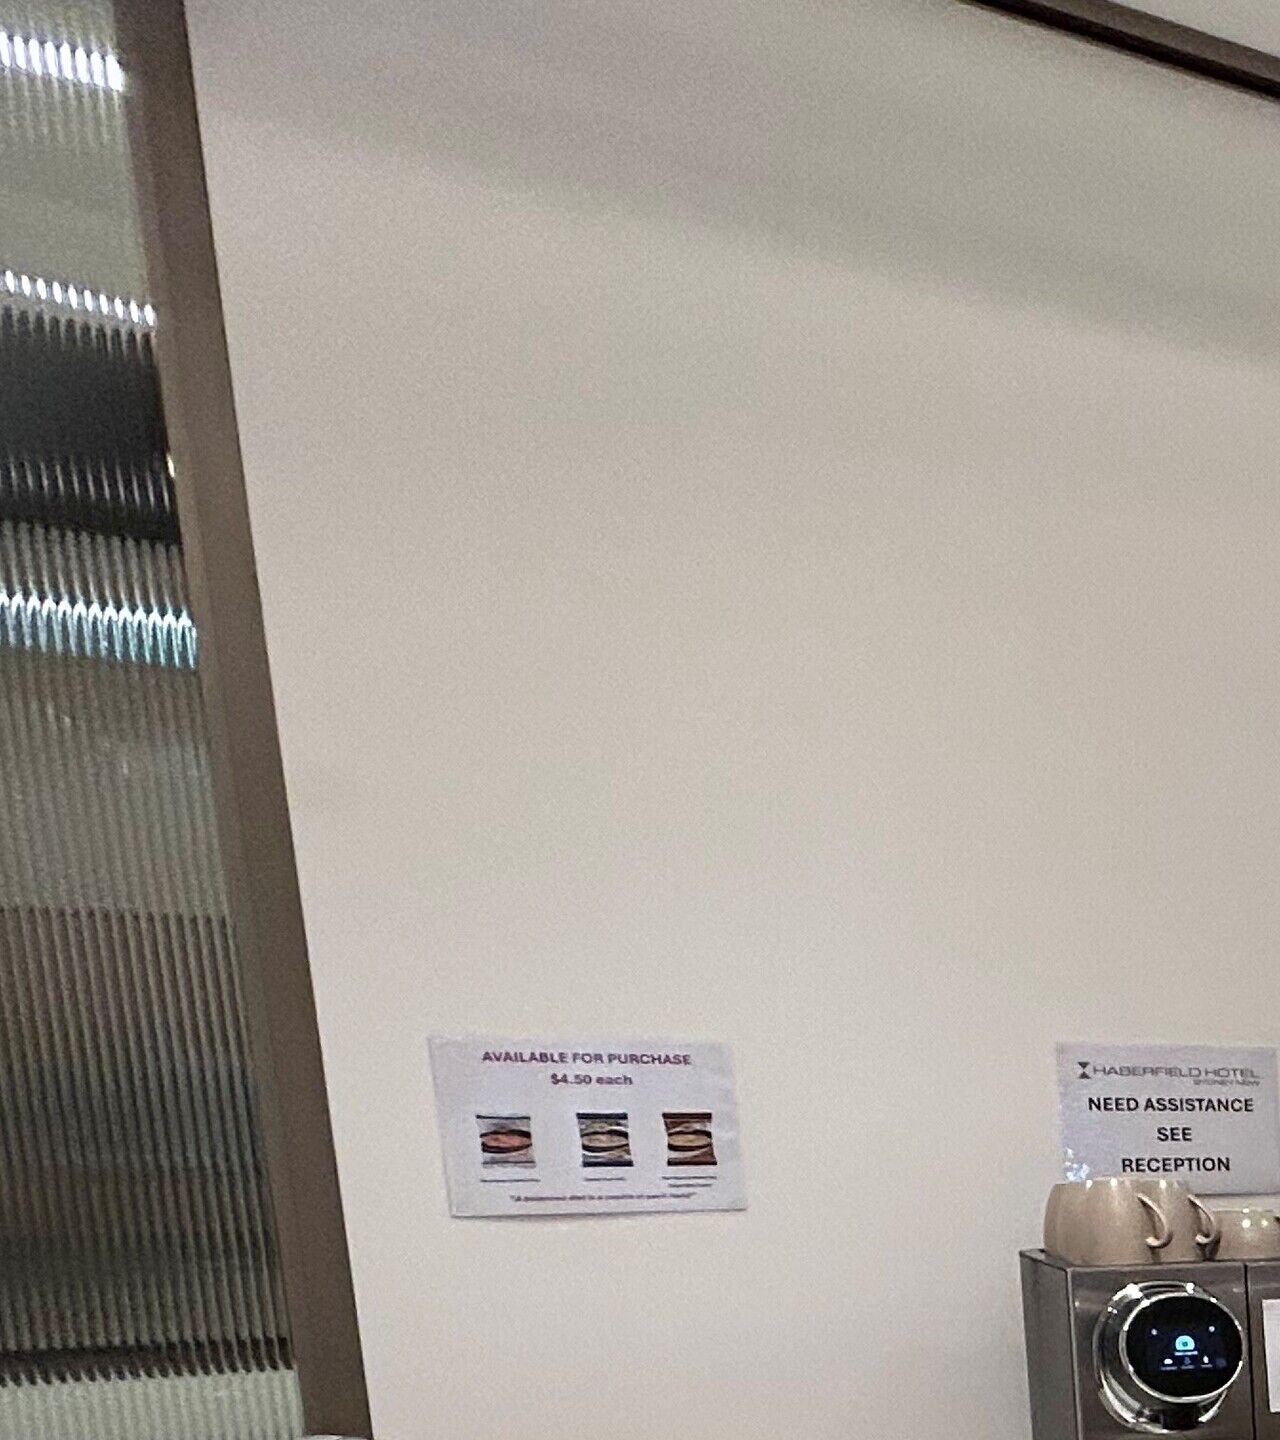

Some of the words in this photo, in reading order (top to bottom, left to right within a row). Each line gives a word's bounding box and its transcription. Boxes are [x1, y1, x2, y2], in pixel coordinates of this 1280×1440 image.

[482, 1051, 568, 1064] AVAILABLE
[572, 1052, 604, 1065] FOR
[608, 1053, 691, 1065] PURCHASE
[1093, 1064, 1201, 1078] HABERFIELD
[1205, 1067, 1261, 1079] HOTEL
[551, 1073, 592, 1086] $4.50
[596, 1074, 633, 1086] each
[1088, 1097, 1139, 1112] NEED
[1144, 1097, 1254, 1112] ASSISTANCE
[1157, 1127, 1192, 1142] SEE
[1122, 1157, 1231, 1173] RECEPTION
